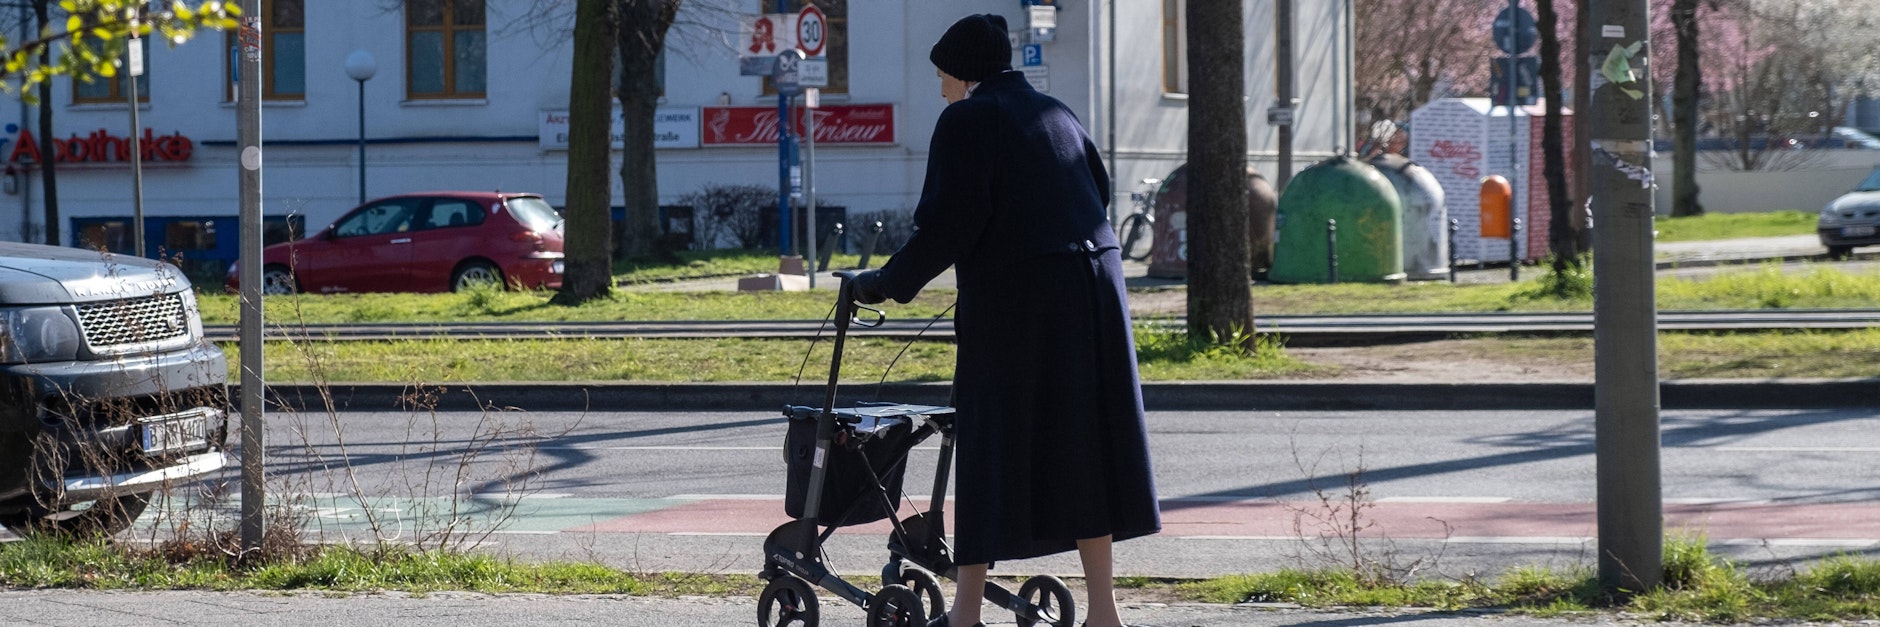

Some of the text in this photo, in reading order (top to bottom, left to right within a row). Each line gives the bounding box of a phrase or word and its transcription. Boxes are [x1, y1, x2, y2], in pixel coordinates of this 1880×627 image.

[803, 20, 819, 42] 30
[1024, 46, 1036, 64] P
[801, 110, 886, 141] Friseur
